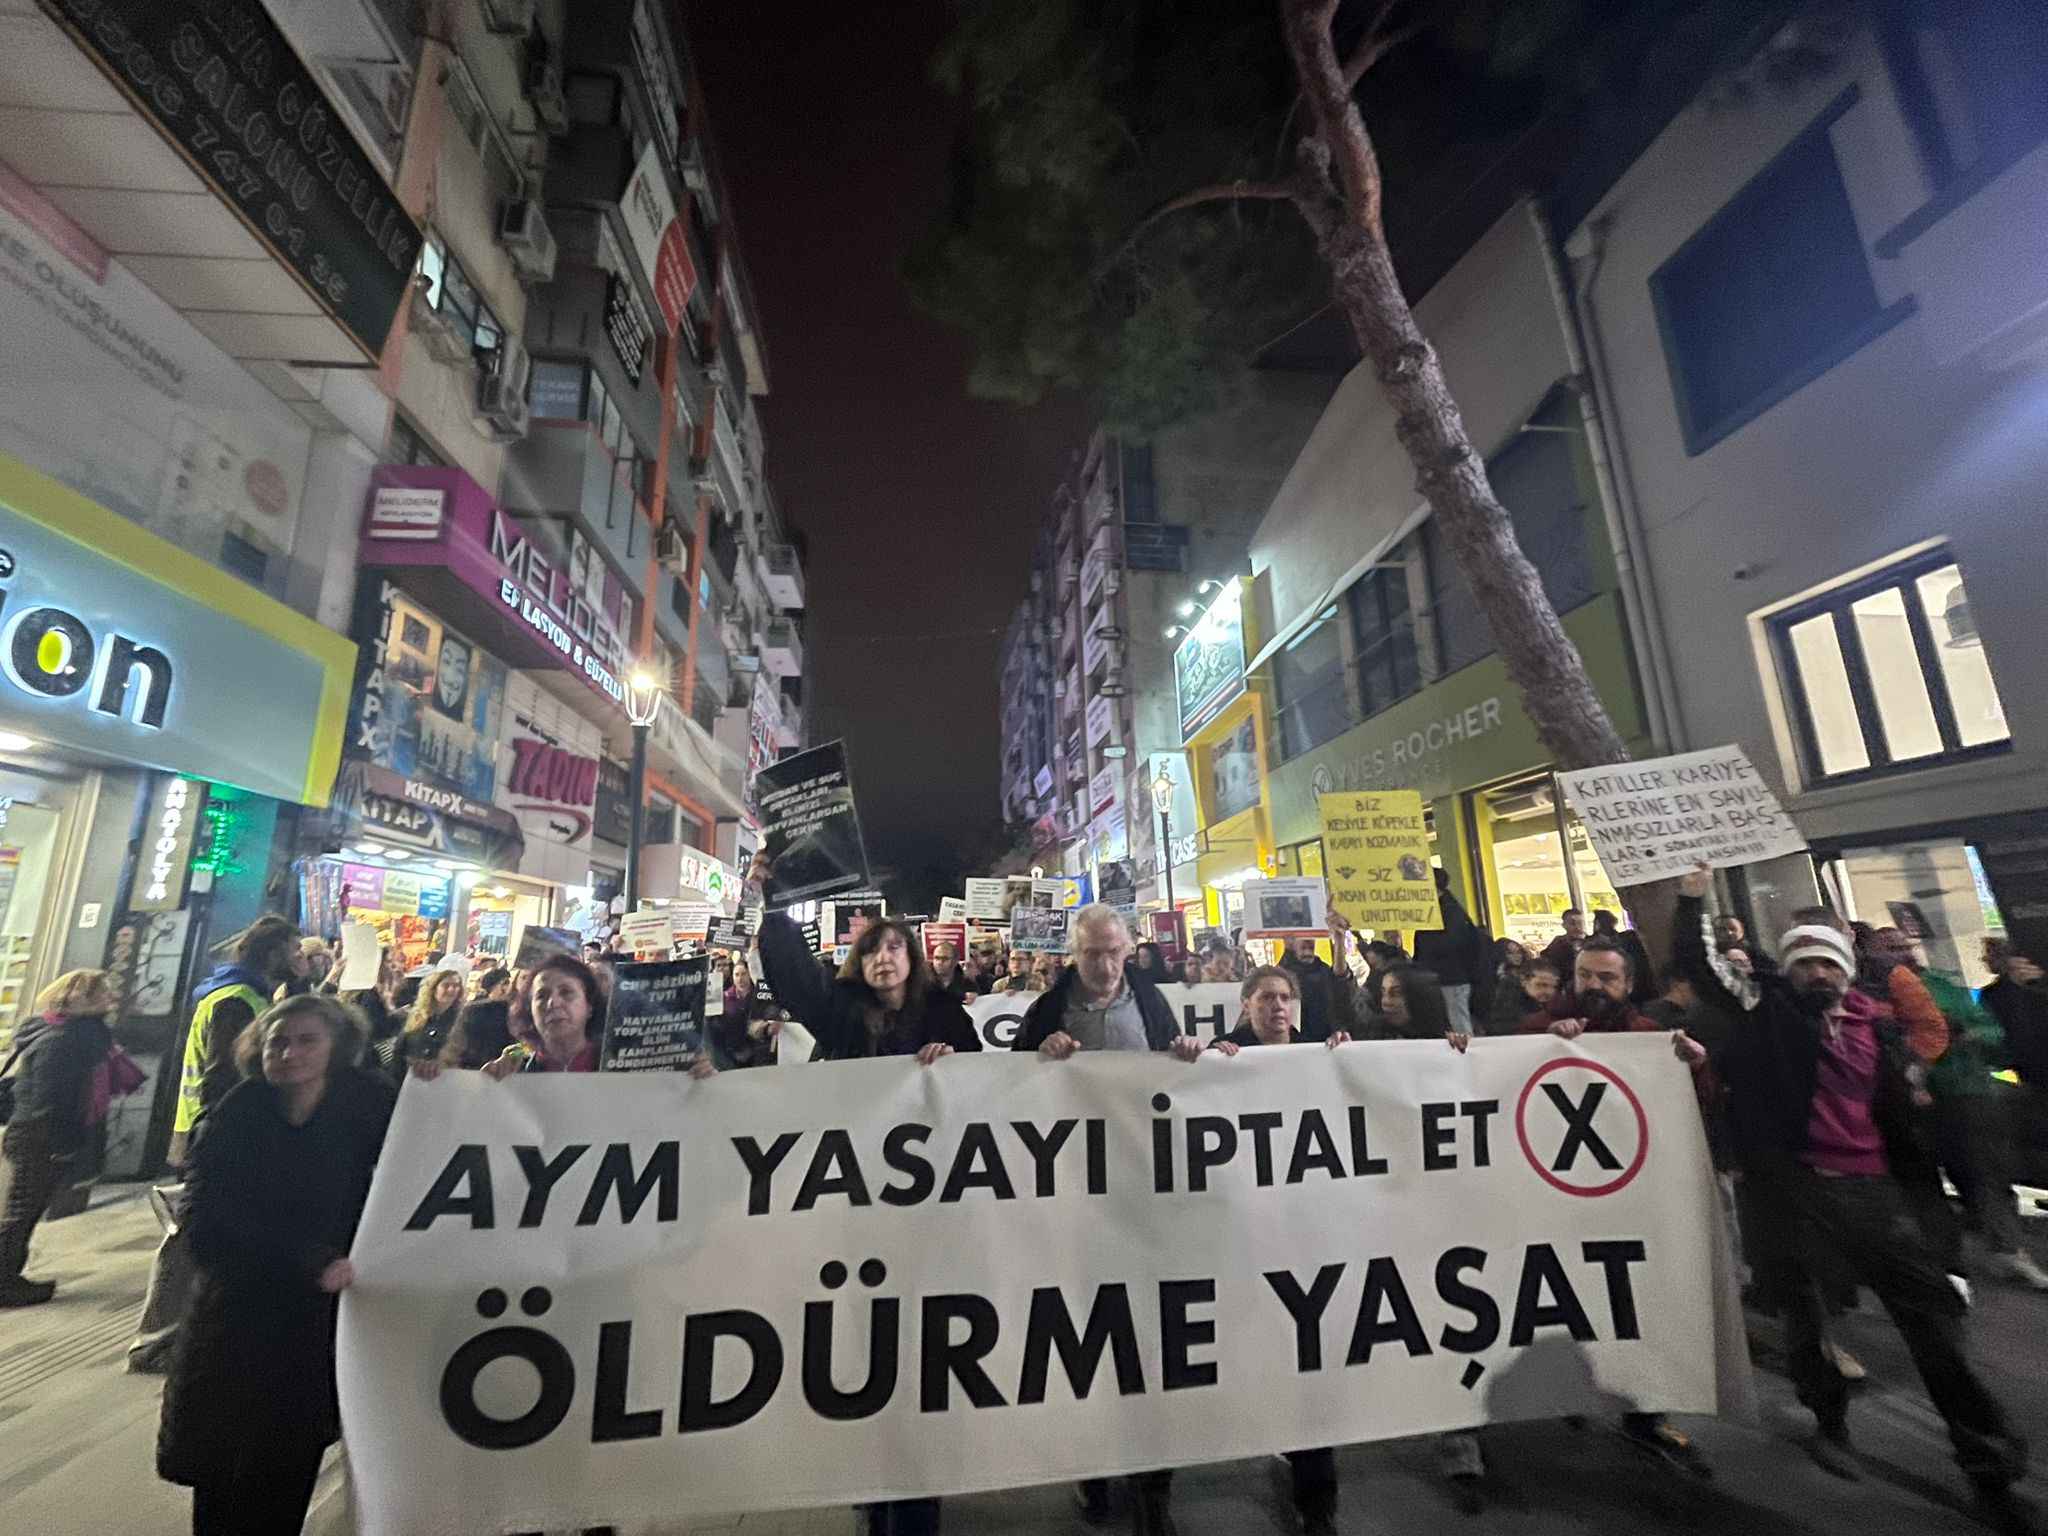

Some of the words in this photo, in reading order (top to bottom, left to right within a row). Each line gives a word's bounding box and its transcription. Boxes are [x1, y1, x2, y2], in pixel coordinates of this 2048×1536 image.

[1392, 697, 1501, 766] ROCHER
[1676, 794, 1704, 814] EN
[404, 1140, 680, 1231] AYM
[731, 1118, 1107, 1217] YASAYI
[1151, 1092, 1388, 1194] İPTAL
[1420, 1100, 1499, 1172] ET
[1540, 1082, 1624, 1172] X
[440, 1258, 1218, 1451] ÖLDÜRME
[1262, 1240, 1647, 1390] YAŞAT
